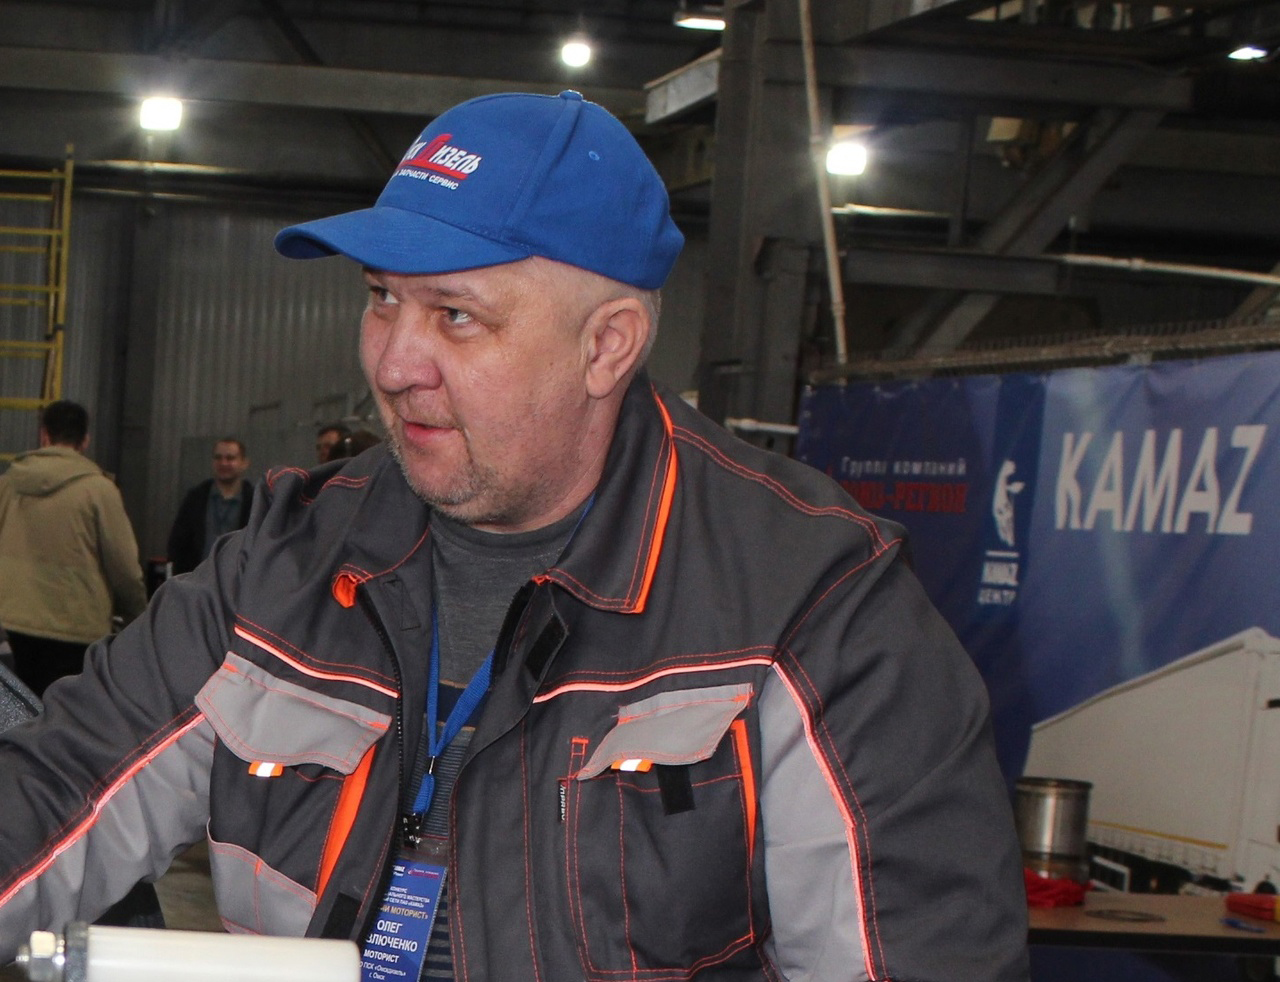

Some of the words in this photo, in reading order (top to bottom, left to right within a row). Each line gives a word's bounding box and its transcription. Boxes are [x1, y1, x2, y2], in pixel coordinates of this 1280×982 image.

[428, 174, 459, 190] СЕРВИС
[1055, 424, 1268, 535] KAMAZ
[376, 919, 404, 934] ОЛЕГ
[363, 949, 400, 963] МОТОРИСТ
